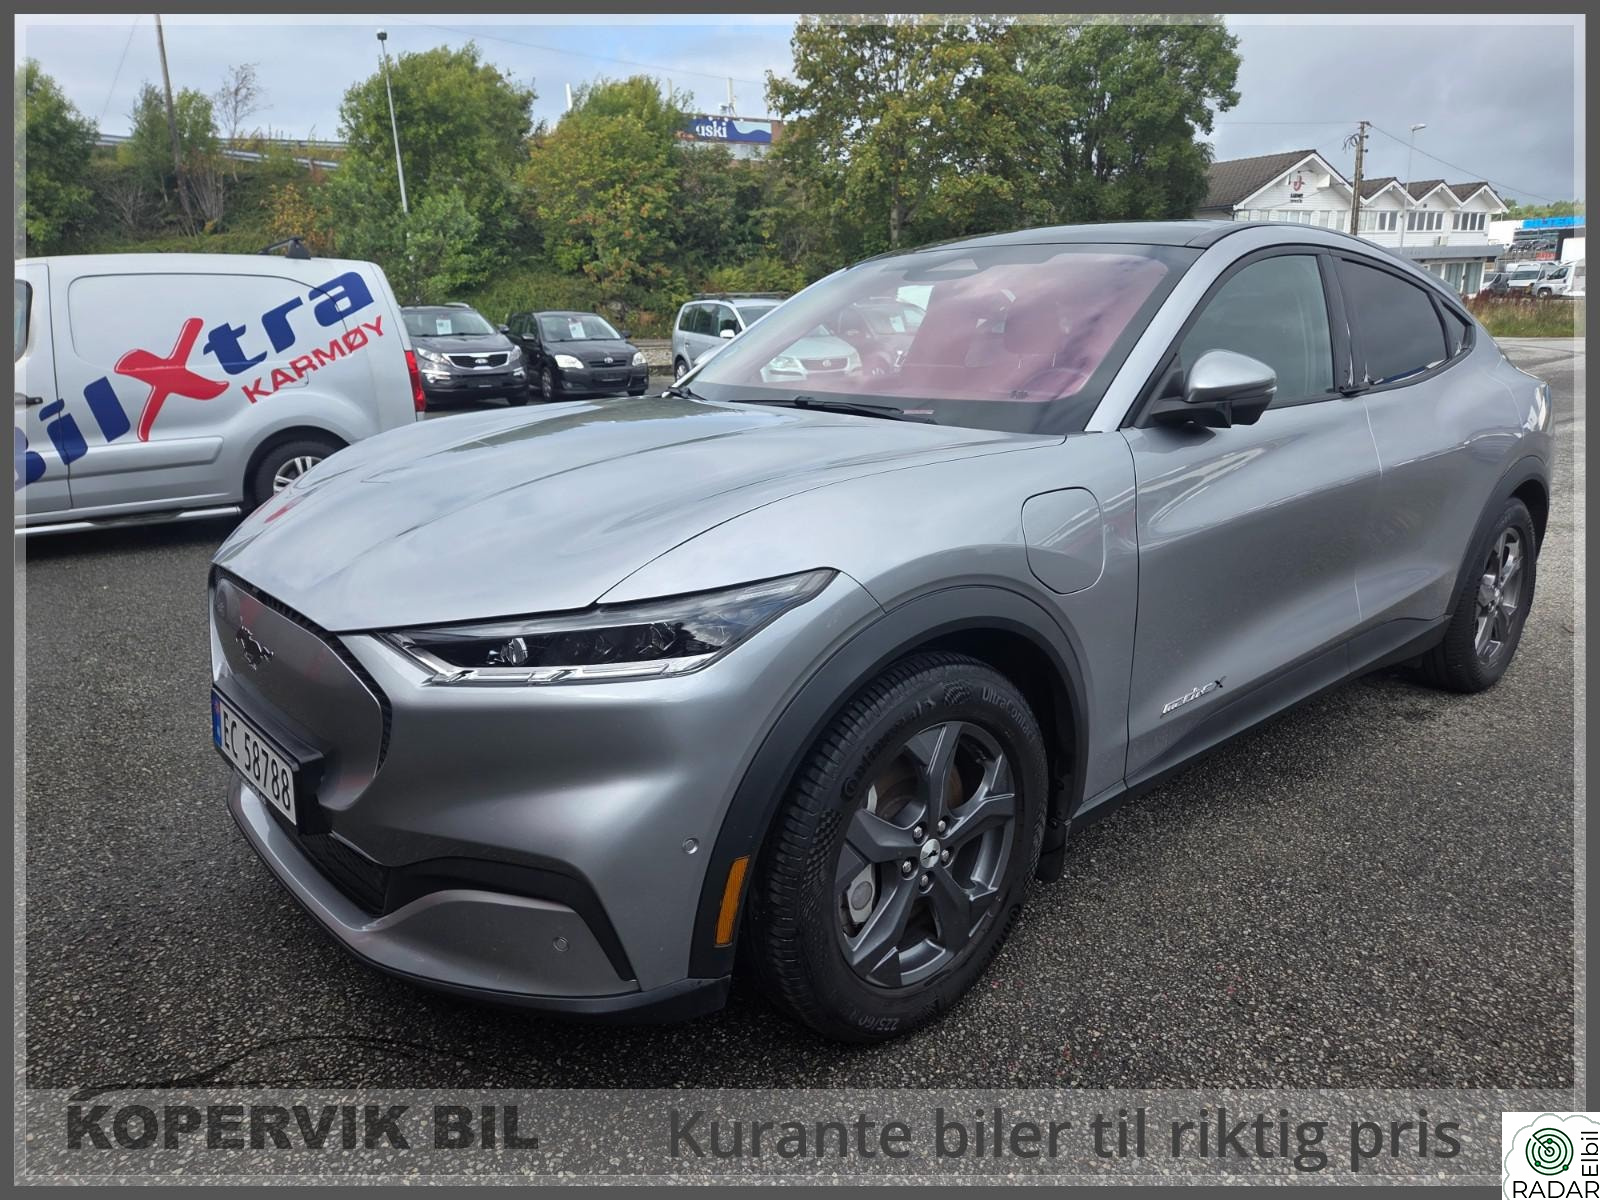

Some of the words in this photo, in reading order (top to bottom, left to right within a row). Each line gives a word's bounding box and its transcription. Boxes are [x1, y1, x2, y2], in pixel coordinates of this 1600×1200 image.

[241, 315, 384, 404] KARMØY
[223, 710, 238, 759] EC
[244, 732, 291, 811] 58788
